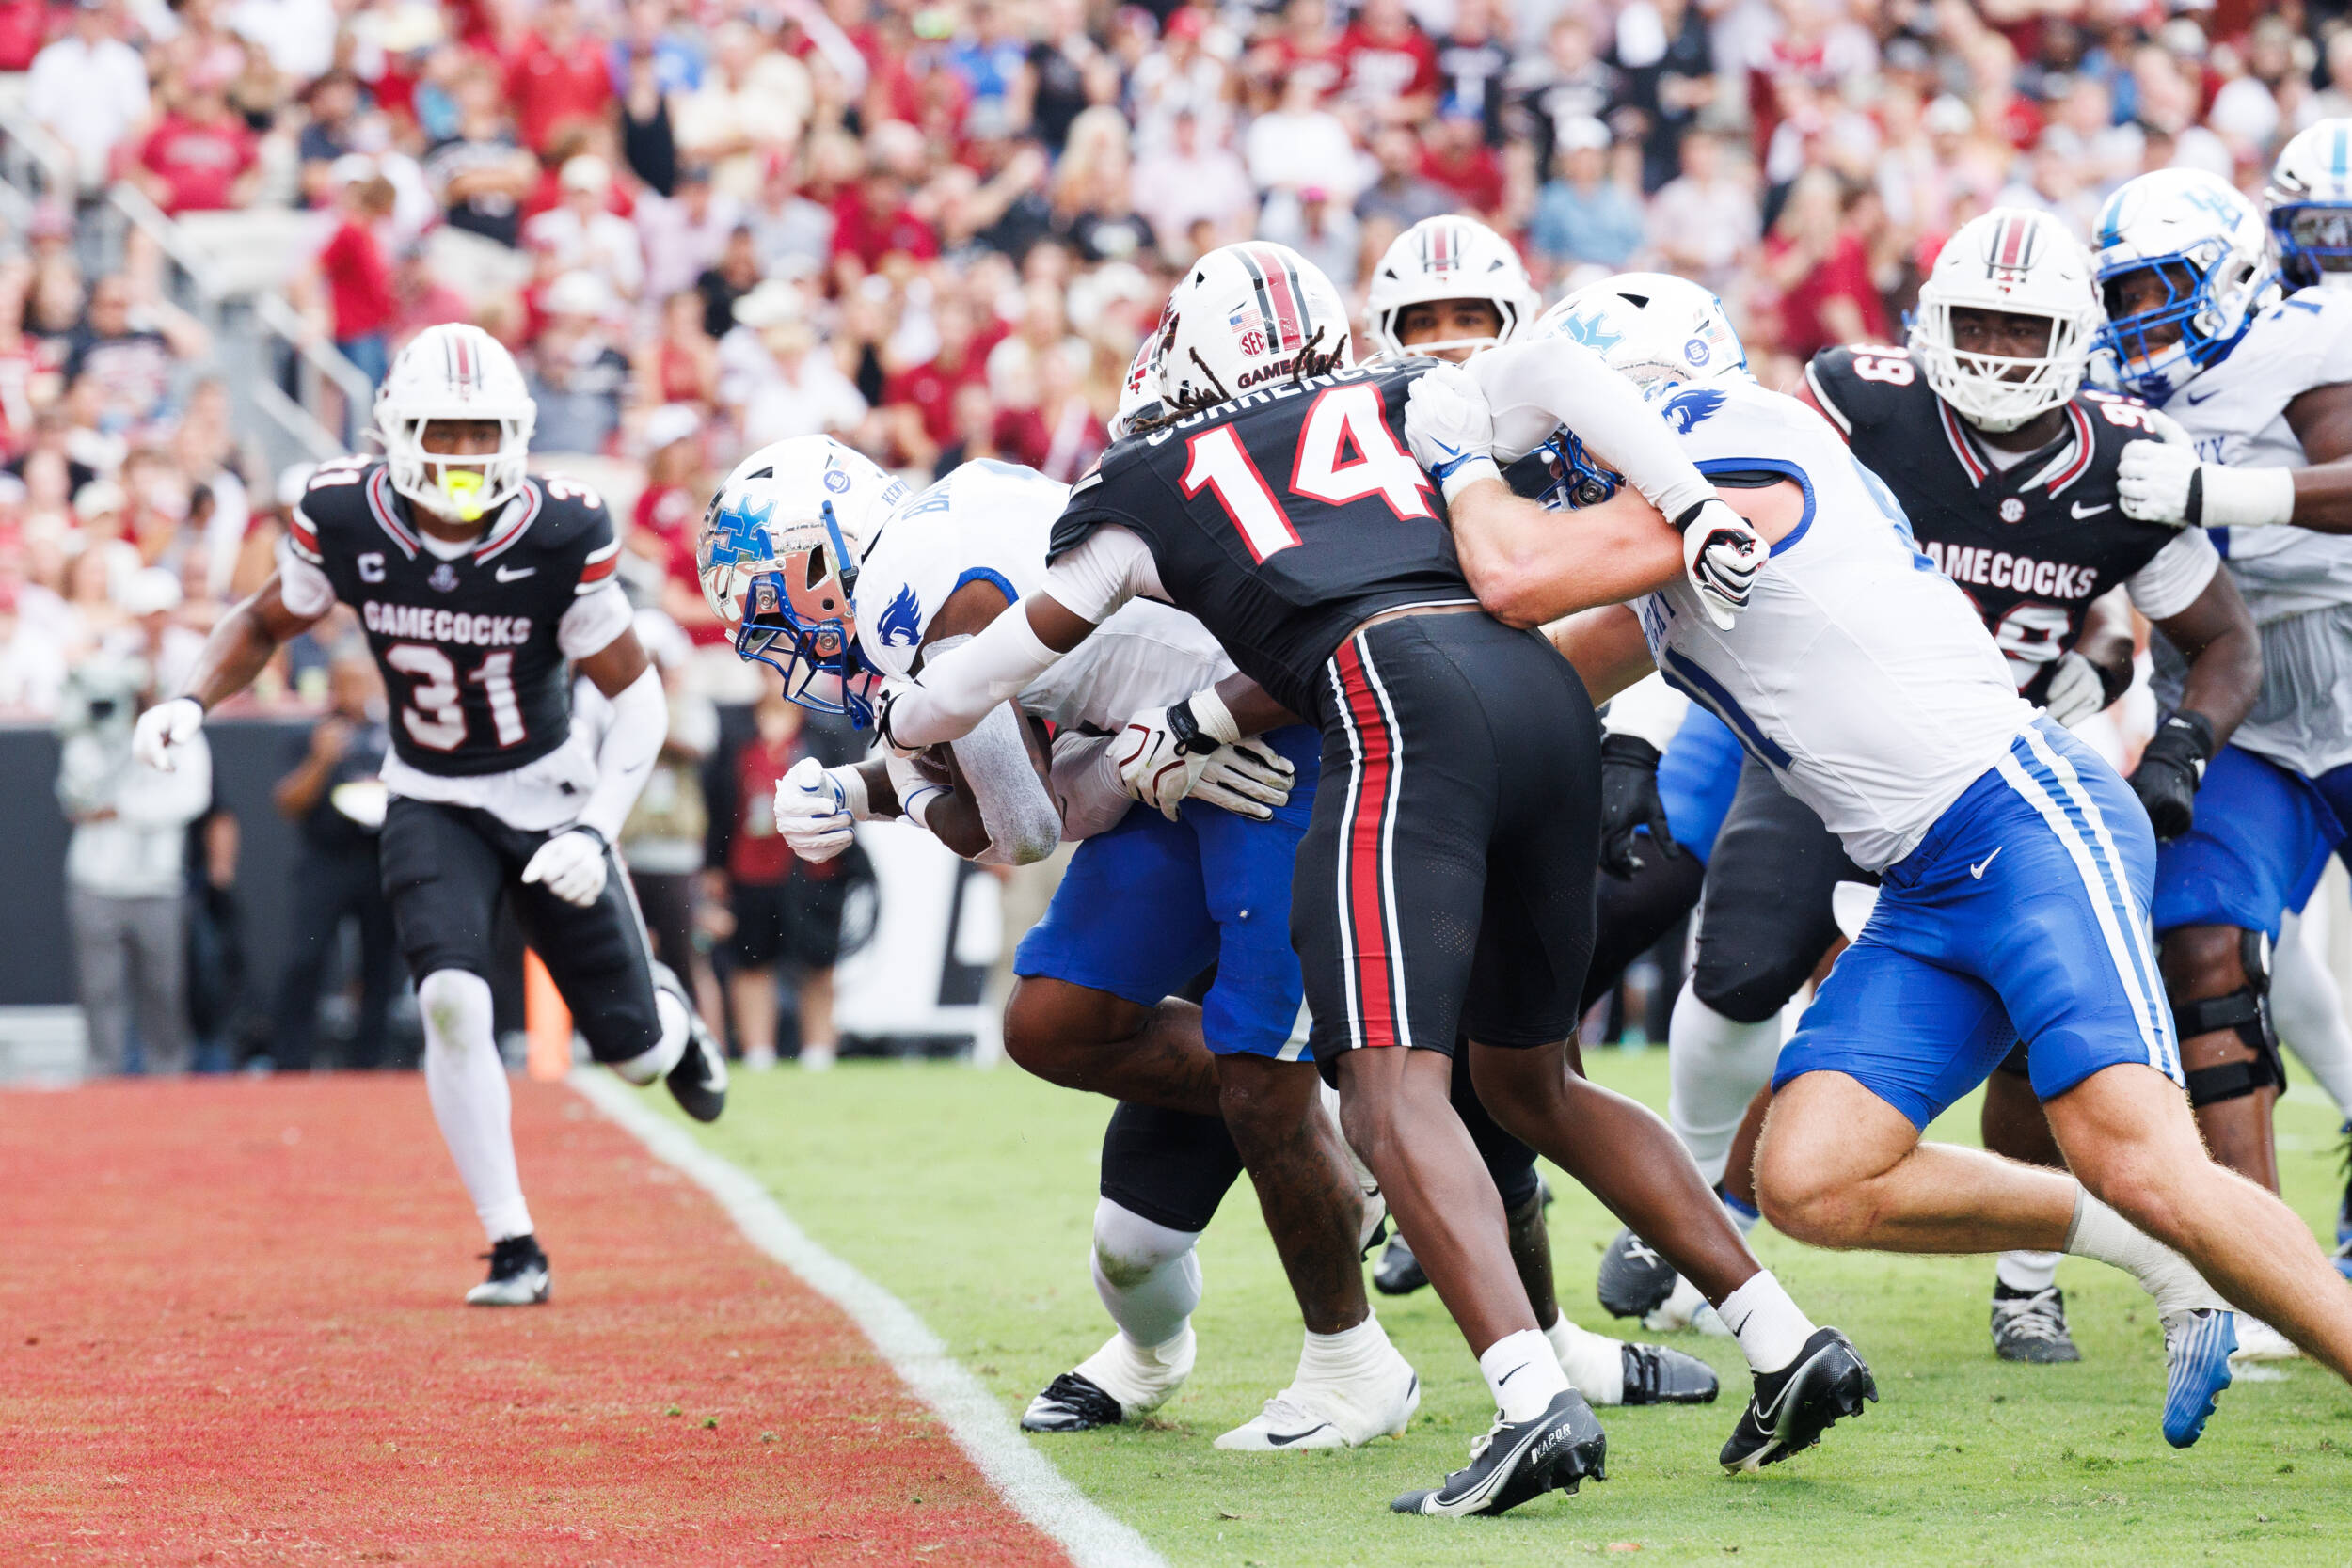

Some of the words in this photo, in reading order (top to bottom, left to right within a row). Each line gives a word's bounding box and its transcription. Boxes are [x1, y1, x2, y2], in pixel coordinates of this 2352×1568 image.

[1242, 332, 1265, 356] SEC
[1178, 422, 1442, 566] 14
[358, 552, 386, 583] C
[1914, 539, 2099, 599] AMECOCKS
[362, 599, 532, 646] GAMECOCKS
[386, 642, 529, 753] 31
